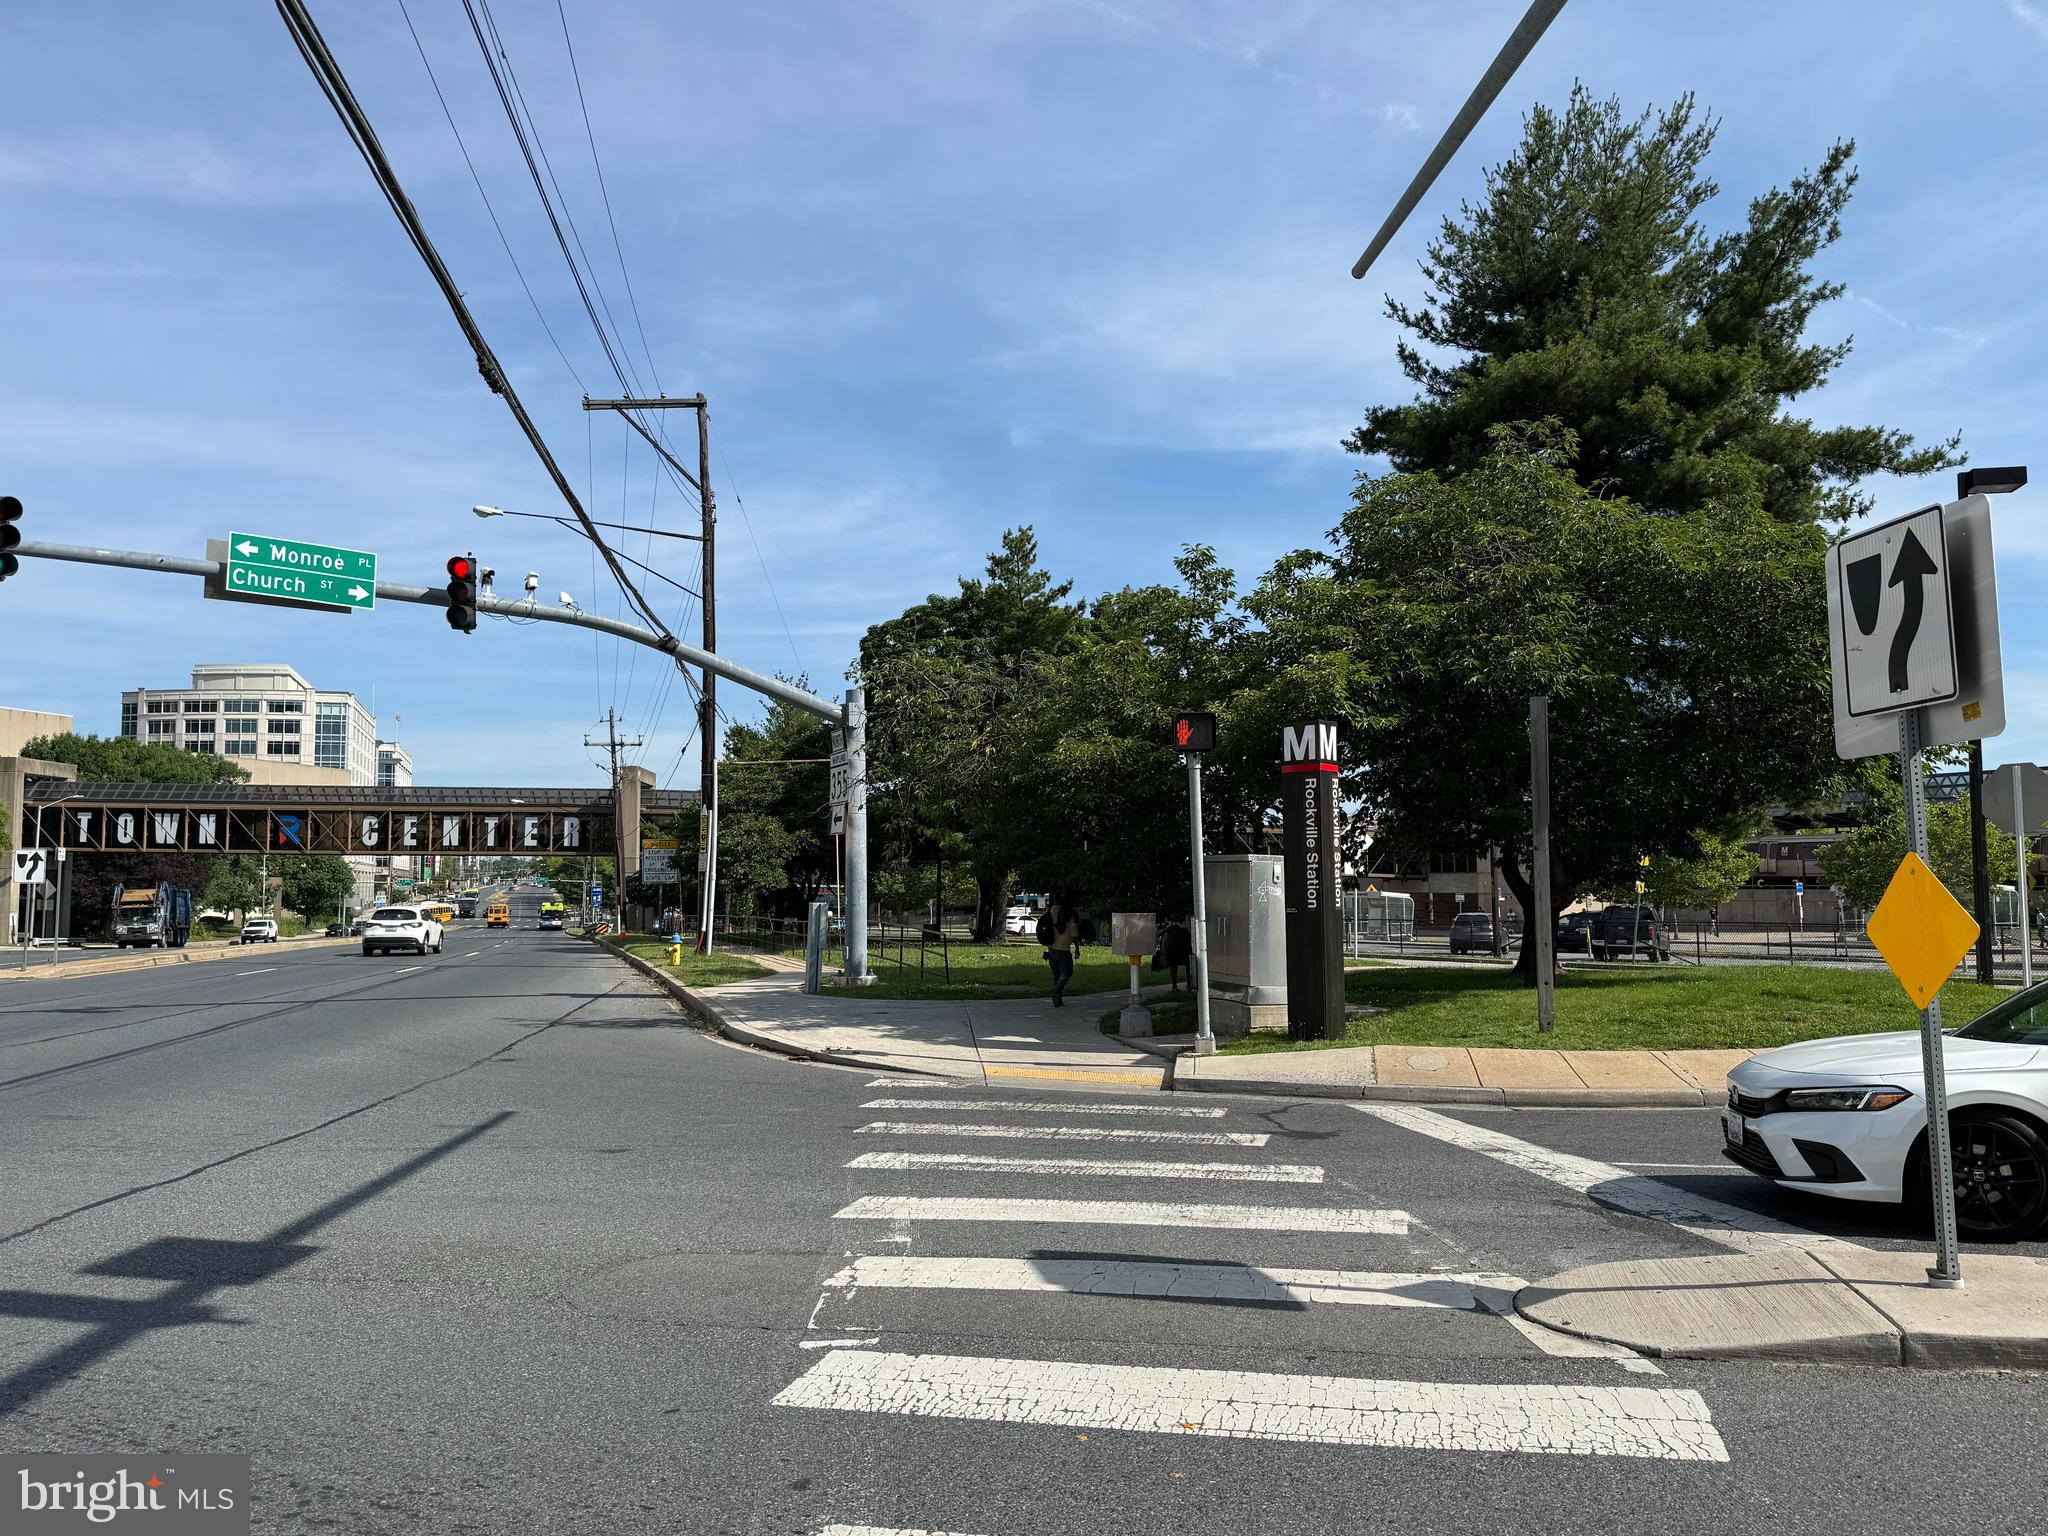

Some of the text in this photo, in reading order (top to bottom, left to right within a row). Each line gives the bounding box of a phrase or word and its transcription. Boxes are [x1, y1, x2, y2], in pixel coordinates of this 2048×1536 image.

[271, 545, 372, 570] Monroe PL
[232, 568, 333, 593] Church ST
[1283, 724, 1316, 762] M
[1319, 723, 1338, 762] M
[831, 769, 847, 799] 355
[77, 812, 217, 845] TOWN
[362, 815, 582, 847] CENTER
[1305, 778, 1319, 909] Rockville Station
[1331, 778, 1342, 907] Rockville Station
